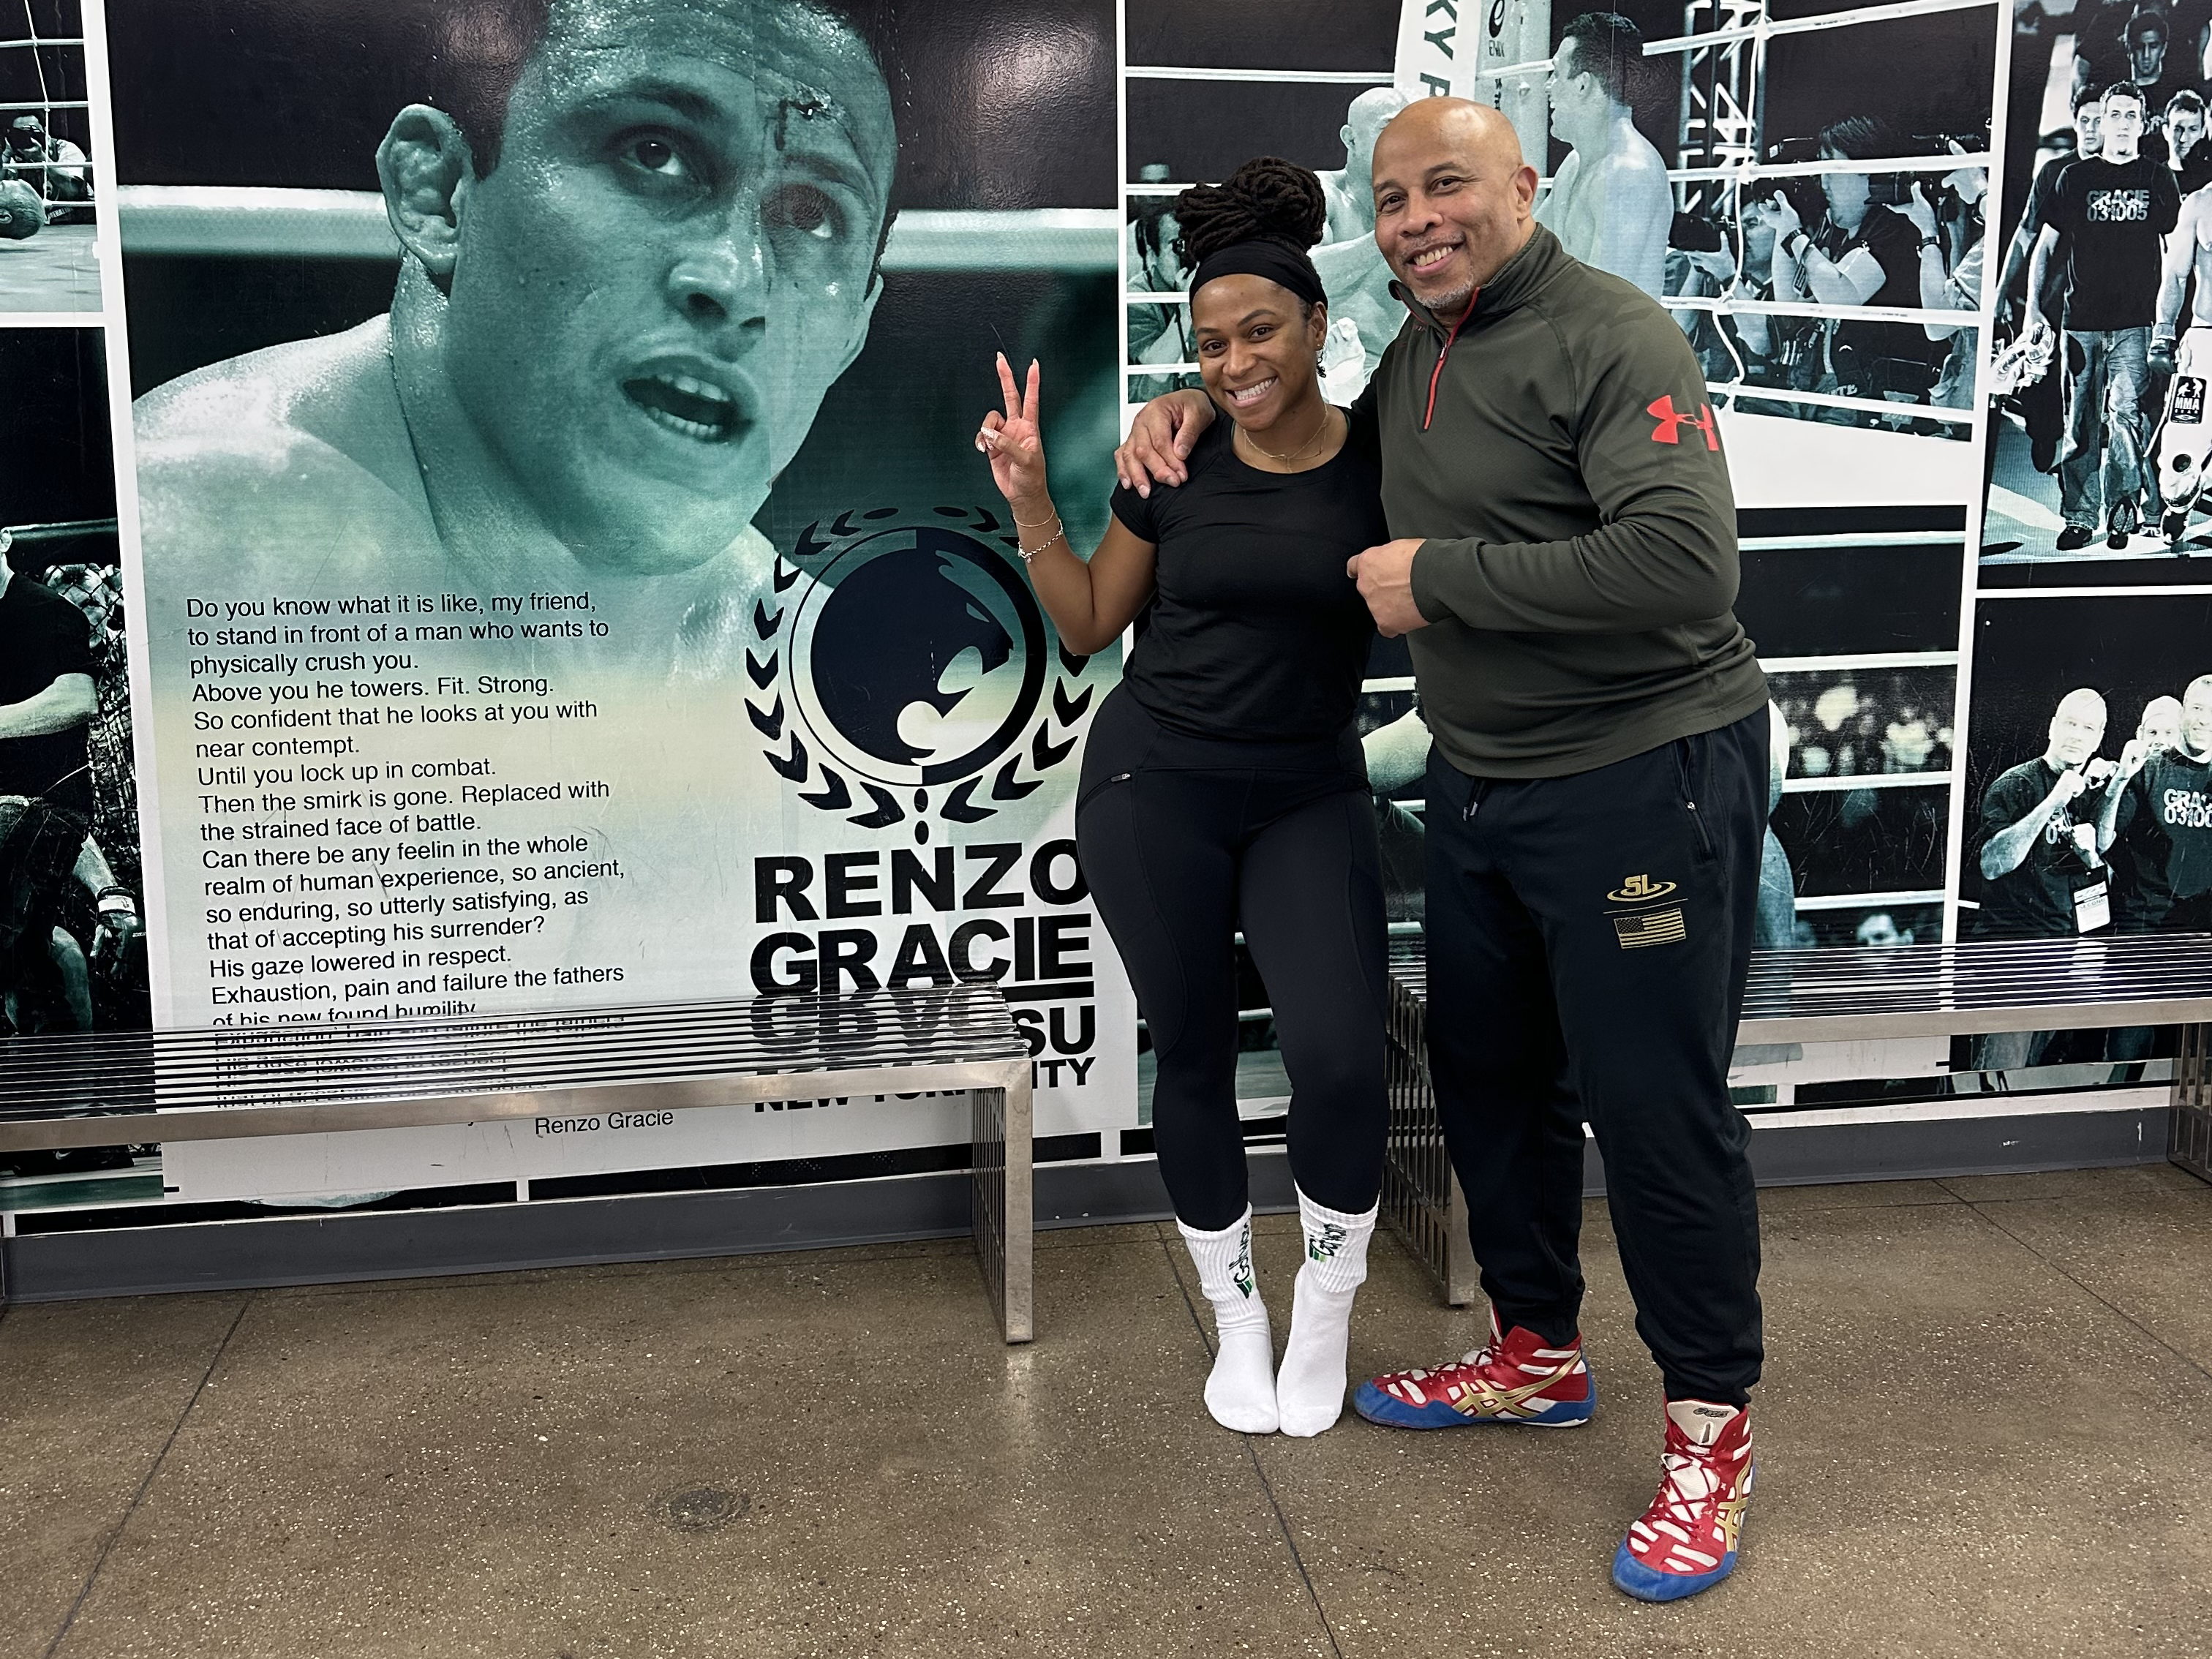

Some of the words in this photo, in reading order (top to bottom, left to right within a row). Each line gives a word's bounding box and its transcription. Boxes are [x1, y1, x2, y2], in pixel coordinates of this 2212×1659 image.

[2086, 189, 2150, 208] GRACIE
[2174, 396, 2200, 410] MMA
[187, 598, 219, 617] Do
[225, 601, 265, 622] you
[273, 597, 331, 616] know
[337, 595, 391, 614] what
[397, 595, 410, 613] it
[416, 594, 434, 613] is
[441, 593, 484, 615] like,
[492, 597, 524, 616] my
[529, 591, 595, 613] friend,
[187, 628, 209, 646] to
[216, 625, 277, 646] stand
[284, 625, 304, 644] in
[309, 625, 361, 643] front
[366, 623, 388, 642] of
[394, 627, 409, 642] a
[415, 625, 462, 641] man
[468, 621, 514, 639] who
[520, 620, 583, 639] wants
[588, 620, 609, 636] to
[190, 653, 298, 679] physically
[305, 651, 366, 672] crush
[372, 655, 418, 674] you.
[192, 683, 262, 702] Above
[268, 685, 309, 705] you
[316, 680, 344, 699] he
[350, 680, 429, 698] towers.
[437, 677, 470, 695] Fit.
[478, 675, 554, 697] Strong.
[194, 711, 224, 731] So
[230, 709, 332, 729] confident
[337, 707, 380, 726] that
[387, 706, 413, 724] he
[421, 704, 478, 723] looks
[484, 703, 505, 721] at
[510, 705, 549, 725] you
[555, 699, 597, 718] with
[196, 742, 246, 758] near
[252, 735, 360, 758] contempt.
[198, 766, 246, 786] Until
[253, 769, 293, 789] you
[301, 762, 345, 782] lock
[352, 765, 378, 784] up
[386, 761, 404, 779] in
[411, 758, 496, 778] combat.
[198, 795, 255, 813] Then
[261, 793, 296, 811] the
[304, 790, 363, 810] smirk
[369, 789, 387, 808] is
[394, 790, 454, 810] gone.
[462, 781, 561, 807] Replaced
[568, 780, 609, 799] with
[200, 823, 235, 841] the
[242, 819, 329, 840] strained
[335, 818, 383, 836] face
[389, 815, 410, 834] of
[416, 813, 481, 832] battle.
[203, 850, 247, 869] Can
[253, 848, 310, 867] there
[317, 846, 345, 864] be
[351, 847, 391, 865] any
[396, 840, 455, 860] feelin
[462, 838, 480, 857] in
[486, 838, 520, 856] the
[526, 834, 588, 854] whole
[205, 876, 266, 896] realm
[272, 874, 293, 893] of
[300, 872, 375, 892] human
[380, 866, 504, 890] experience,
[512, 867, 537, 881] so
[543, 859, 624, 880] ancient,
[754, 838, 1091, 924] RENZO
[206, 908, 232, 924] so
[238, 902, 339, 922] enduring,
[347, 902, 373, 917] so
[380, 895, 445, 917] utterly
[452, 889, 557, 913] satisfying,
[564, 890, 589, 906] as
[206, 931, 249, 950] that
[255, 929, 276, 948] of
[282, 925, 385, 949] accepting
[394, 923, 424, 941] his
[430, 915, 545, 939] surrender?
[210, 959, 244, 978] His
[251, 960, 304, 980] gaze
[311, 950, 395, 973] lowered
[402, 949, 421, 968] in
[428, 945, 511, 969] respect.
[750, 913, 1094, 996] GRACIE
[211, 982, 336, 1005] Exhaustion,
[345, 982, 390, 1002] pain
[396, 974, 436, 995] and
[442, 972, 508, 992] failure
[514, 969, 547, 988] the
[552, 966, 624, 985] fathers
[1031, 1056, 1096, 1089] ITY
[535, 1117, 601, 1135] Renzo
[607, 1109, 674, 1129] Gracie
